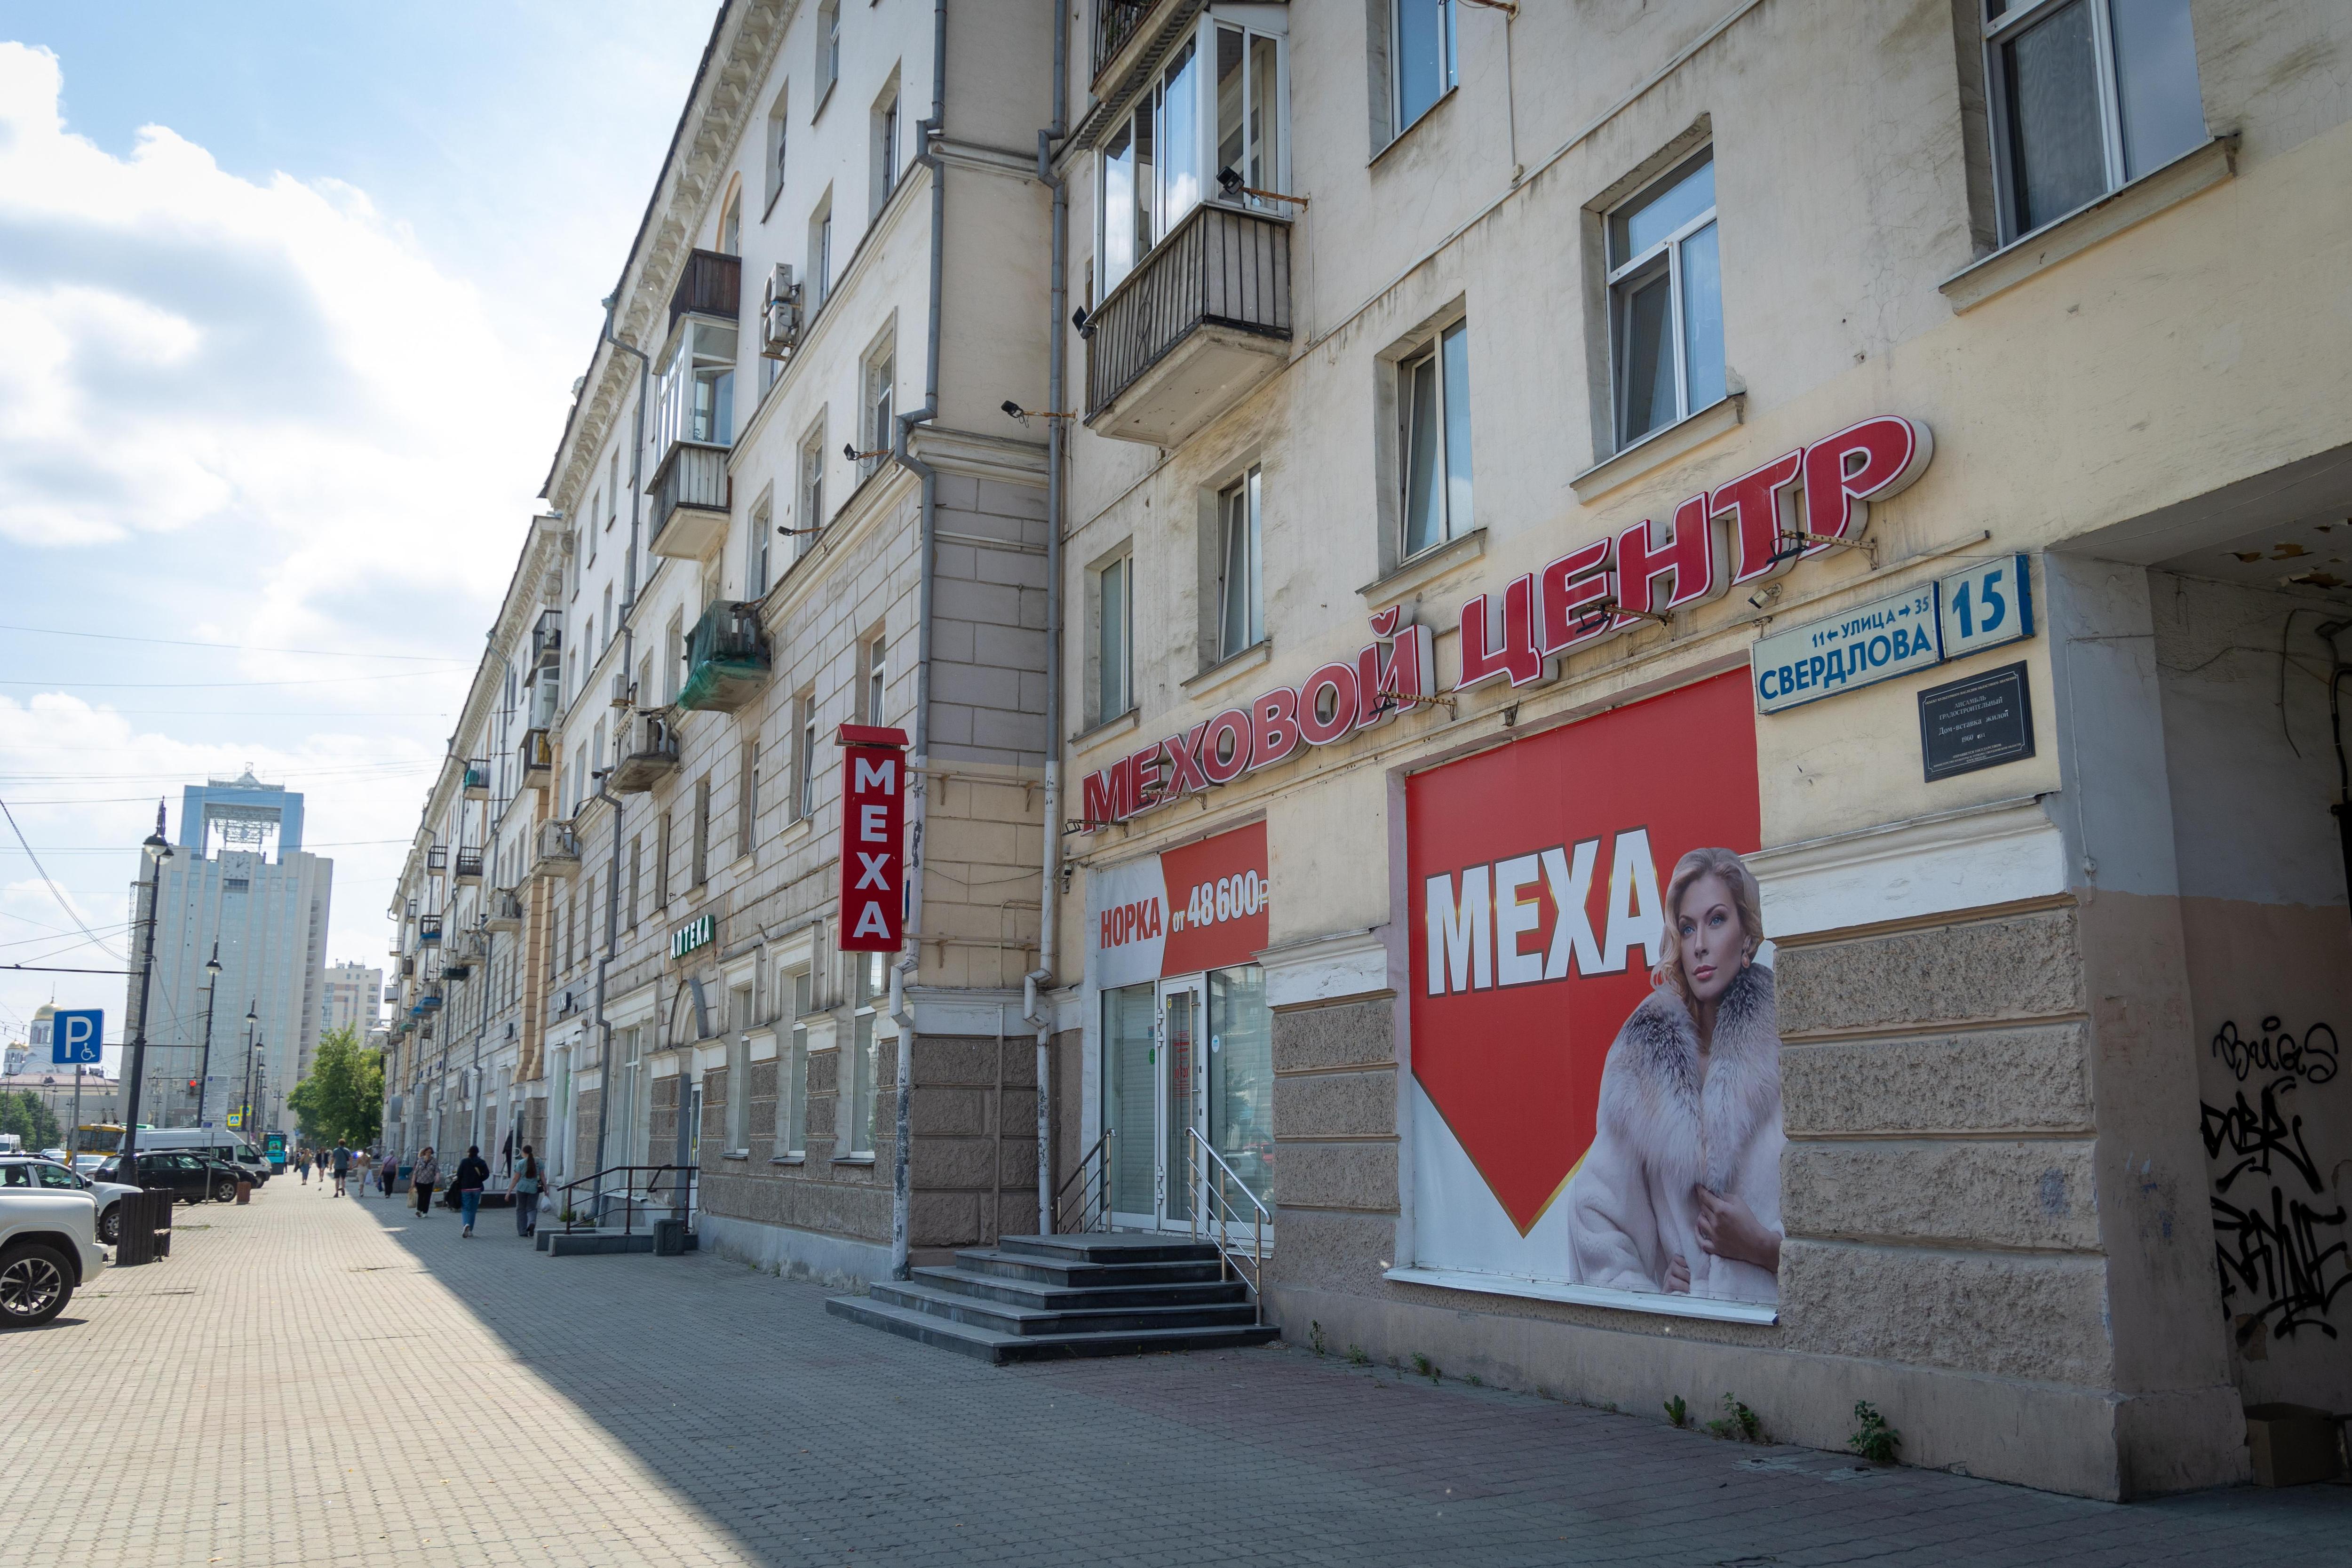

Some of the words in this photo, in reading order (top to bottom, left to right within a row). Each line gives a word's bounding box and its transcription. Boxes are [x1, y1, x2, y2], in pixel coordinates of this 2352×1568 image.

[1080, 605, 1424, 836] МЕХОВОЙ
[1452, 415, 1921, 693] ЦЕНТР
[1812, 632, 1824, 648] 11
[1841, 608, 1896, 639] УЛИЦА
[1915, 596, 1929, 614] 35
[1952, 569, 2005, 639] 15
[1759, 622, 1932, 700] СВЕРДЛОВА
[1938, 717, 1982, 735] Дом-вставка
[1985, 710, 2009, 722] жилой
[1939, 696, 2002, 720] ГРАДОСТРОИТЕЛЬНЫЙ
[1954, 695, 1986, 708] АНСАМБЛЬ
[852, 757, 895, 939] МЕХА
[670, 915, 710, 960] АПТЕКА
[1101, 896, 1162, 949] НОРКА
[1425, 825, 1666, 998] МЕХА
[65, 1016, 93, 1059] P
